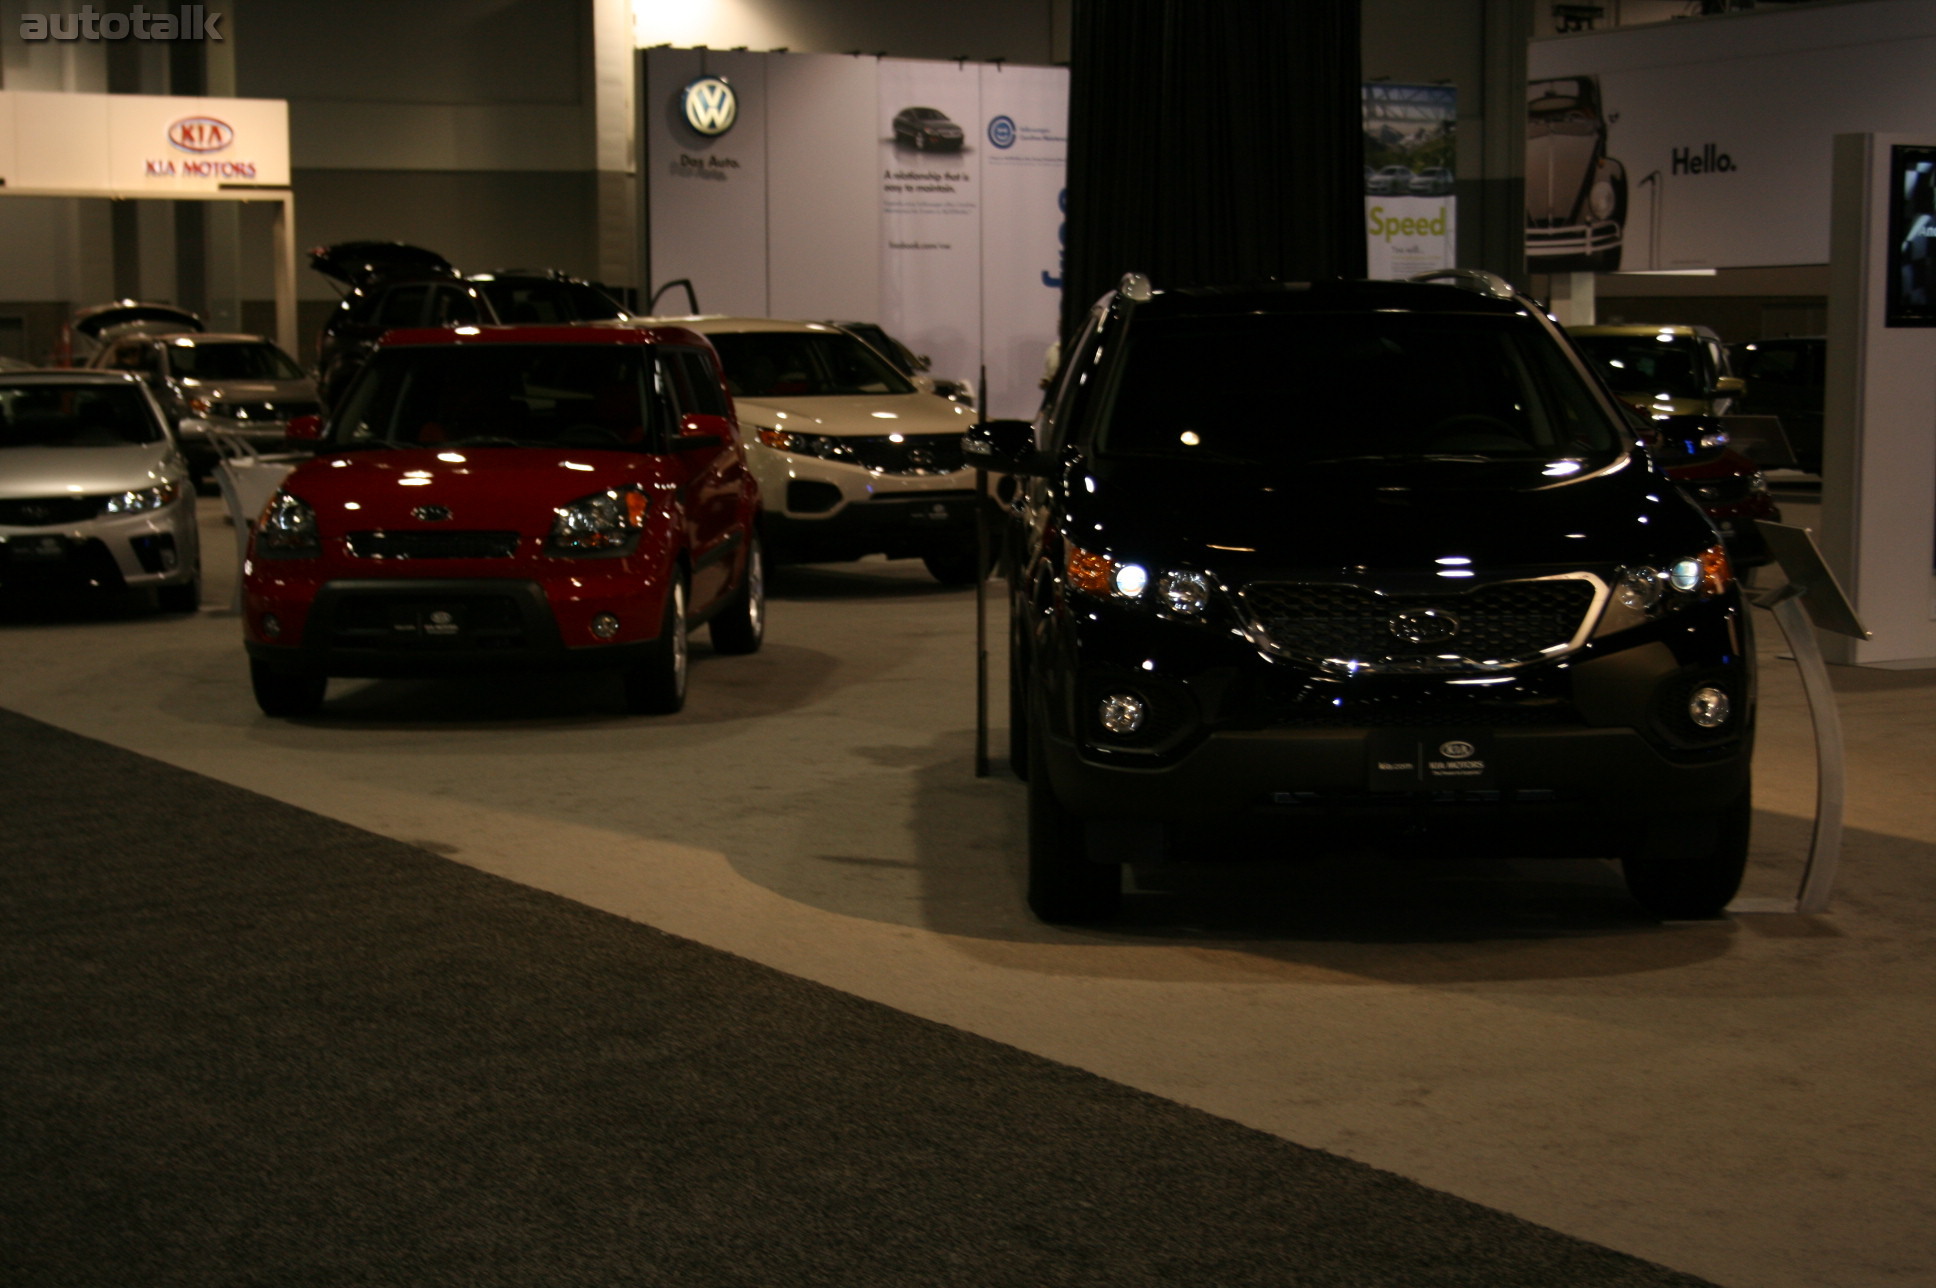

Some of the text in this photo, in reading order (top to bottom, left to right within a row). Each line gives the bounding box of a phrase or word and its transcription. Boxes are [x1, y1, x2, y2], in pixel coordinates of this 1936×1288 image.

[180, 124, 223, 144] KIA
[146, 160, 257, 178] KIA MOTORS
[1672, 144, 1737, 175] Hello.
[1369, 205, 1446, 243] Speed
